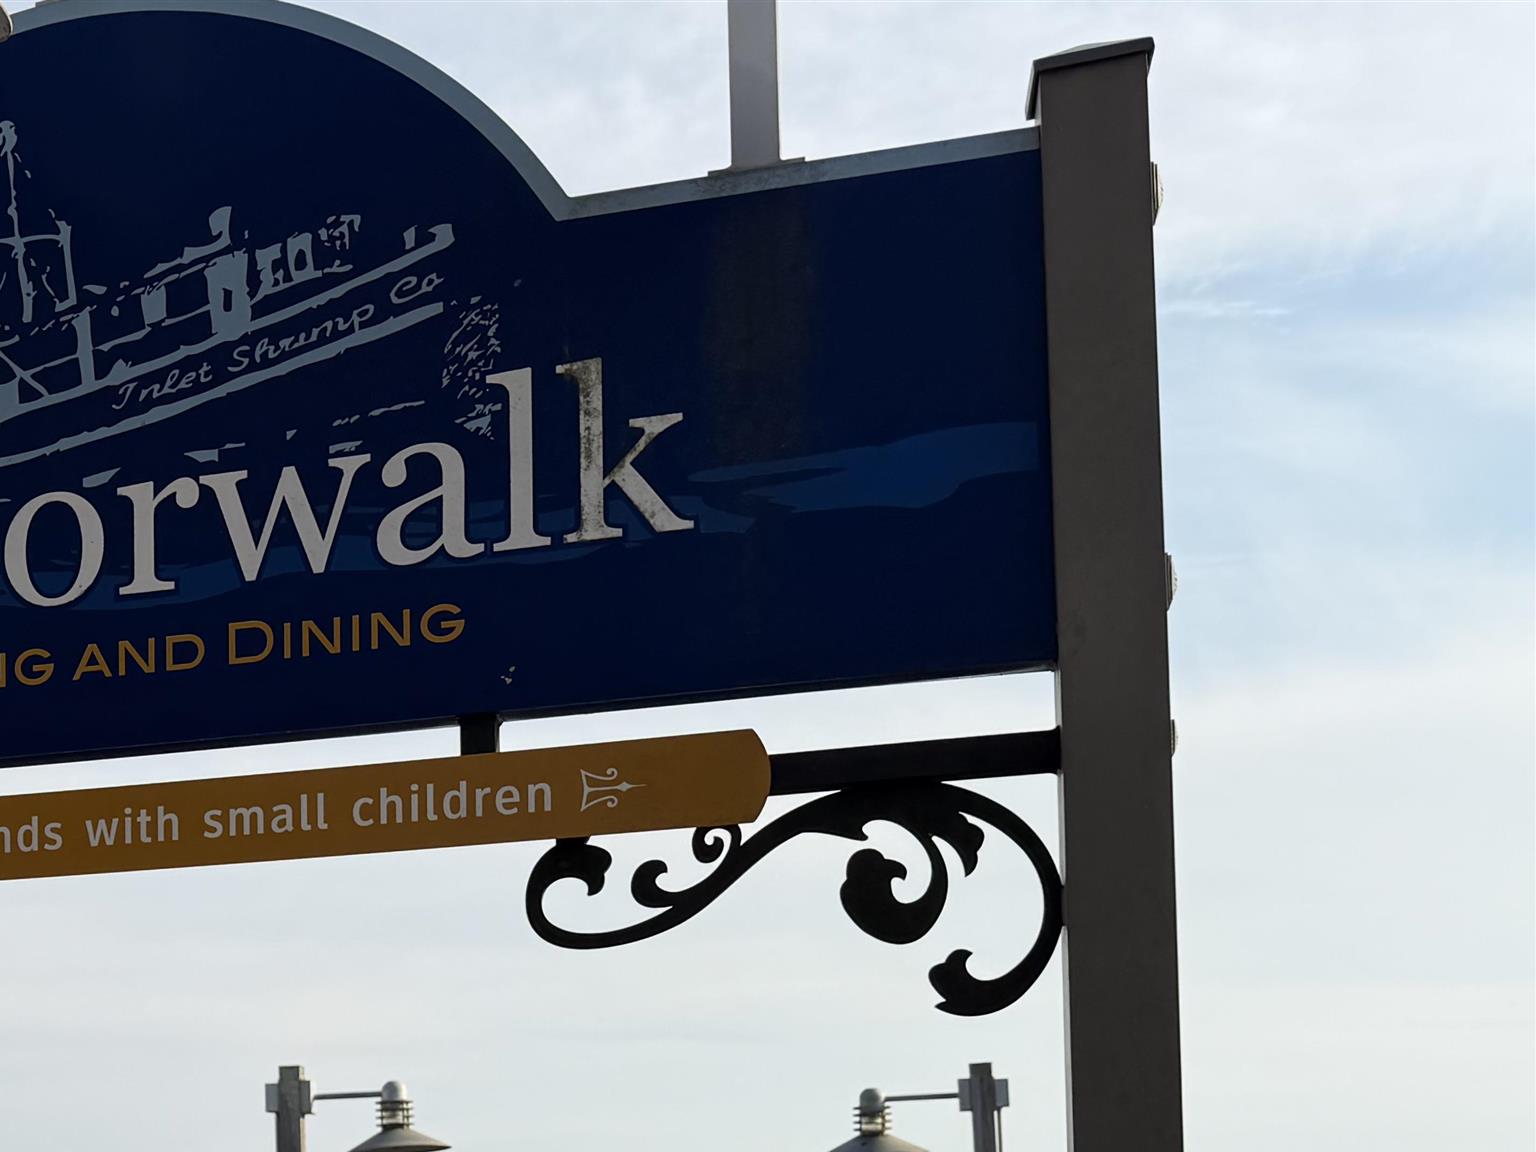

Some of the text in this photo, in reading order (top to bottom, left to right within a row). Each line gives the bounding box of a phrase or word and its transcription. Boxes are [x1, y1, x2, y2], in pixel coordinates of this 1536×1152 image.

[112, 272, 445, 410] Inlet Shrimp Co
[71, 633, 206, 682] AND
[85, 806, 180, 848] with
[202, 793, 329, 838] small
[352, 781, 553, 827] children
